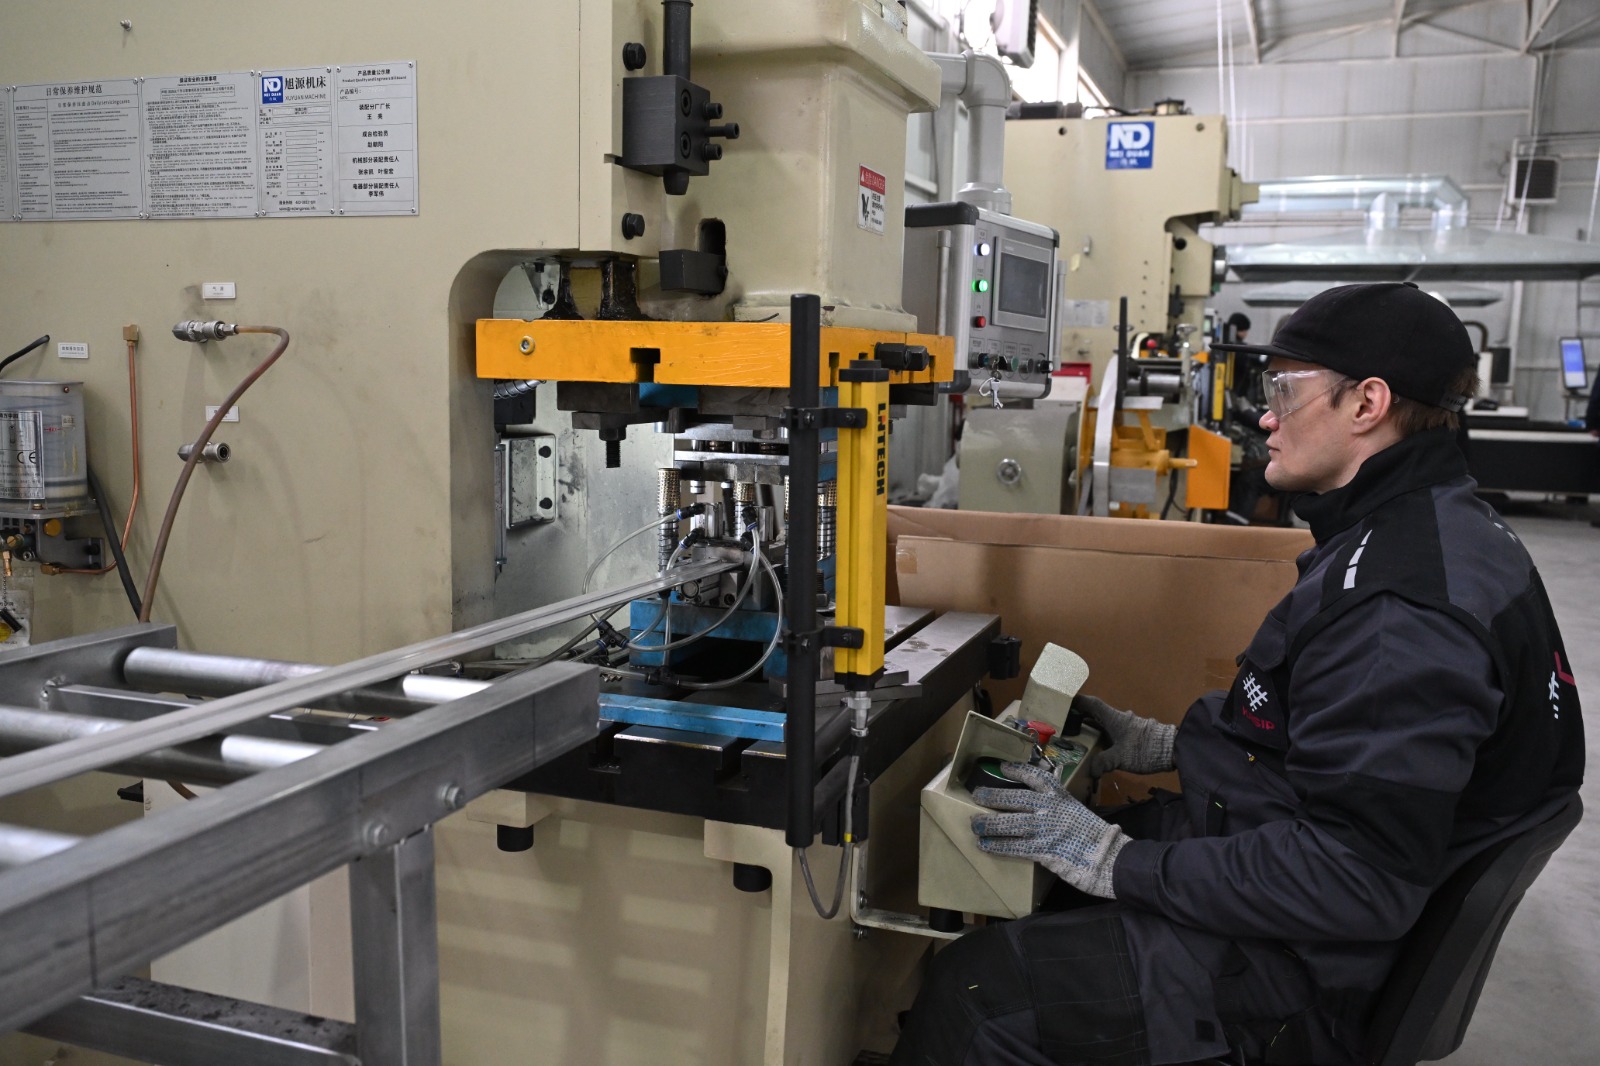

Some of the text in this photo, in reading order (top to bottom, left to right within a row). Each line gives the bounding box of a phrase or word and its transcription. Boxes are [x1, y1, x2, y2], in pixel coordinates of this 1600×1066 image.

[285, 76, 326, 90] 旭源机床
[46, 85, 103, 96] 日常保养维护规范
[1110, 123, 1151, 149] ND
[352, 155, 399, 164] 机械部分装配责任人
